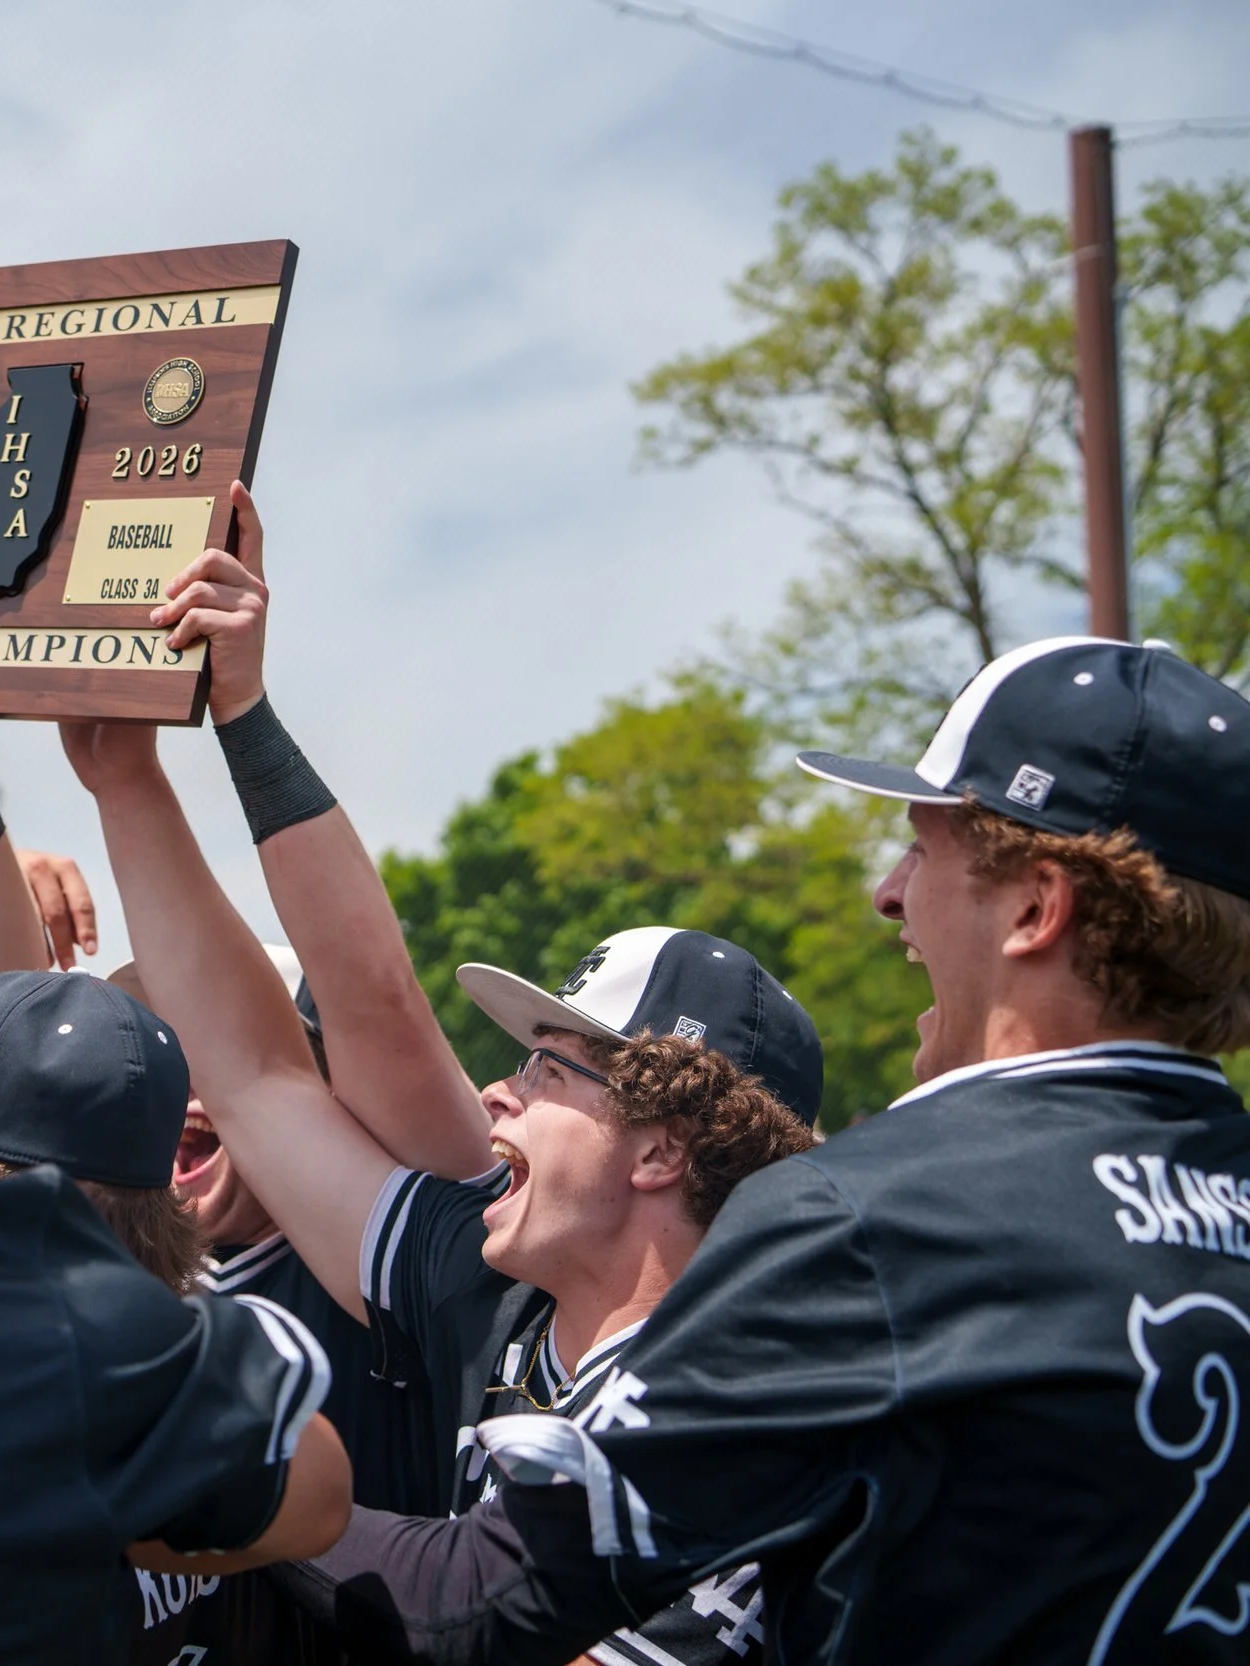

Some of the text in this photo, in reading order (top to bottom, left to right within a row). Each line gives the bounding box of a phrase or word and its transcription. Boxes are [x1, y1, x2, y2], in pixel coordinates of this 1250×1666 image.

[2, 297, 236, 340] REGIONAL
[188, 363, 201, 391] SCHOOL
[111, 443, 201, 478] 2026
[107, 524, 174, 550] BASEBALL
[100, 578, 160, 600] CLASS 3A
[1092, 1153, 1250, 1259] SANS
